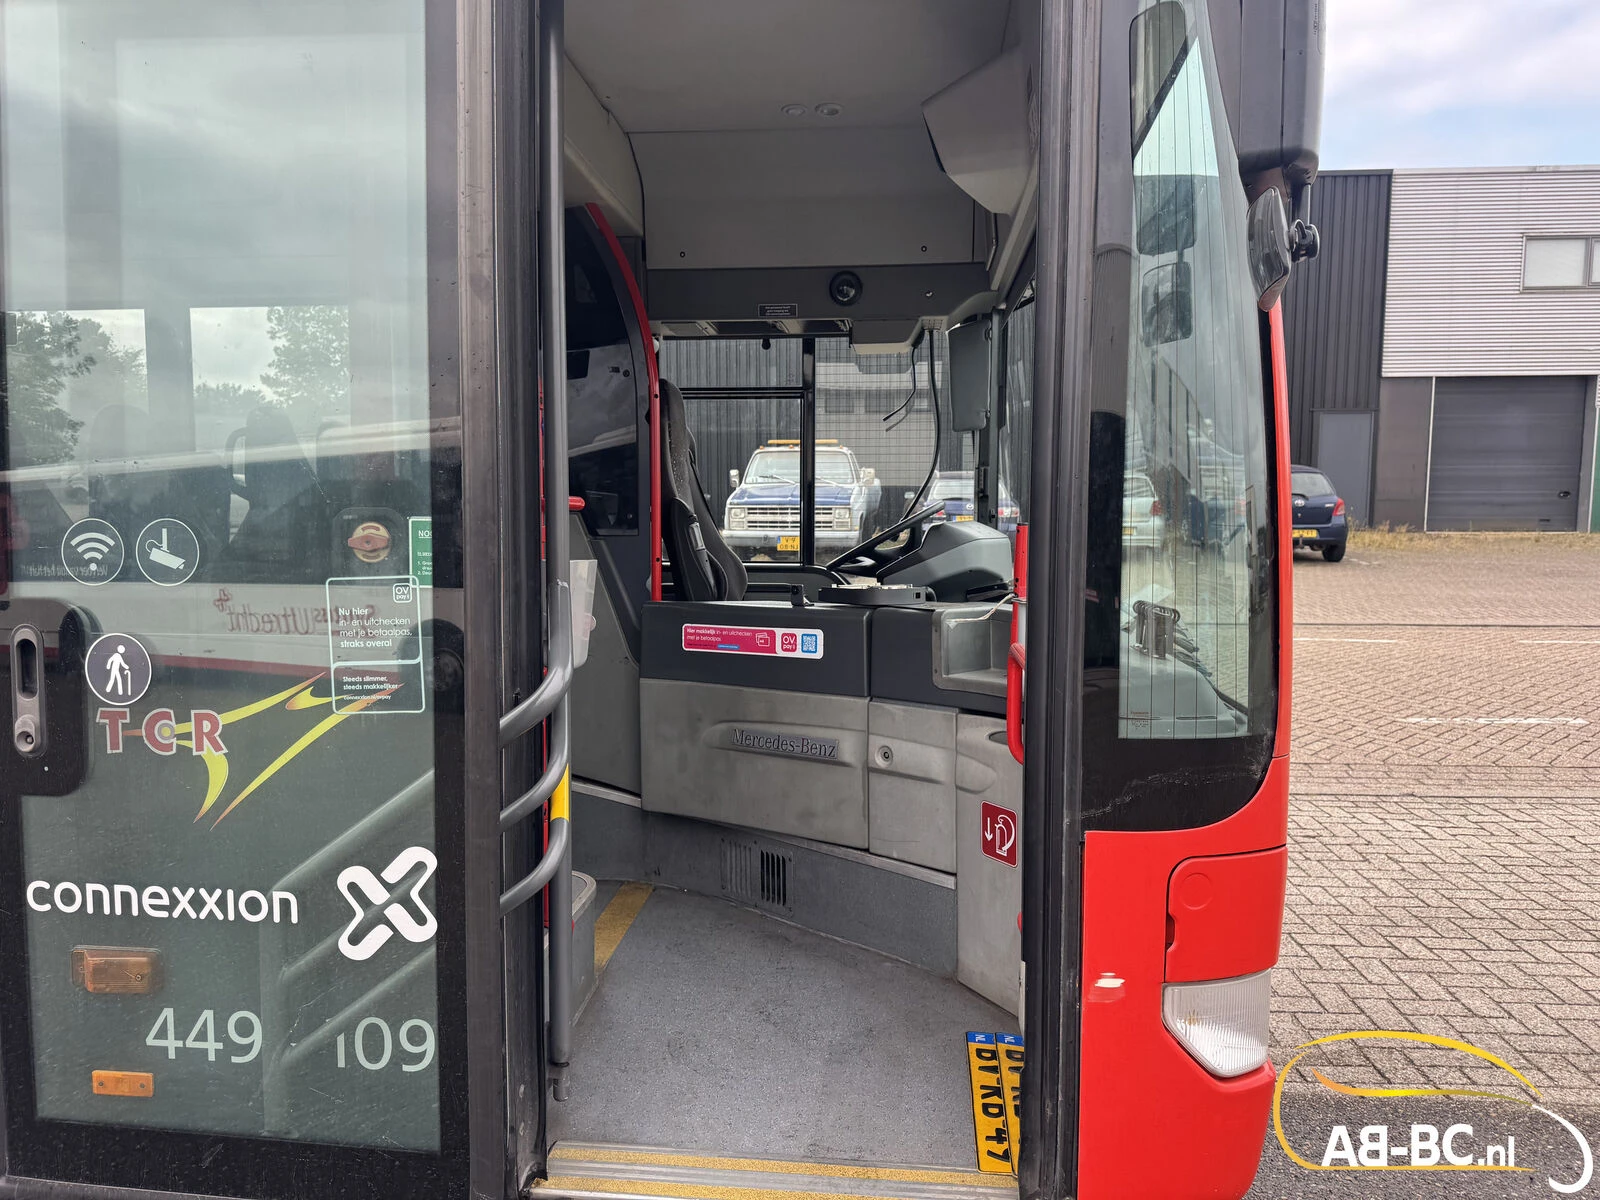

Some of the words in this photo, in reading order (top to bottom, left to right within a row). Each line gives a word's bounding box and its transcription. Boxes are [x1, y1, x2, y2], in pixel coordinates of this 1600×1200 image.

[395, 586, 409, 594] OV
[338, 607, 350, 616] Nu
[352, 607, 368, 616] hier
[339, 618, 350, 626] in-
[364, 617, 411, 626] uitchecken
[340, 629, 356, 637] met
[357, 629, 366, 638] je
[367, 628, 413, 637] betaalpas,
[340, 639, 364, 648] straks
[366, 638, 392, 647] overal
[782, 635, 796, 644] OV
[732, 728, 837, 759] Mercedes-Benz
[26, 880, 298, 924] connexxion
[145, 1007, 264, 1064] 449
